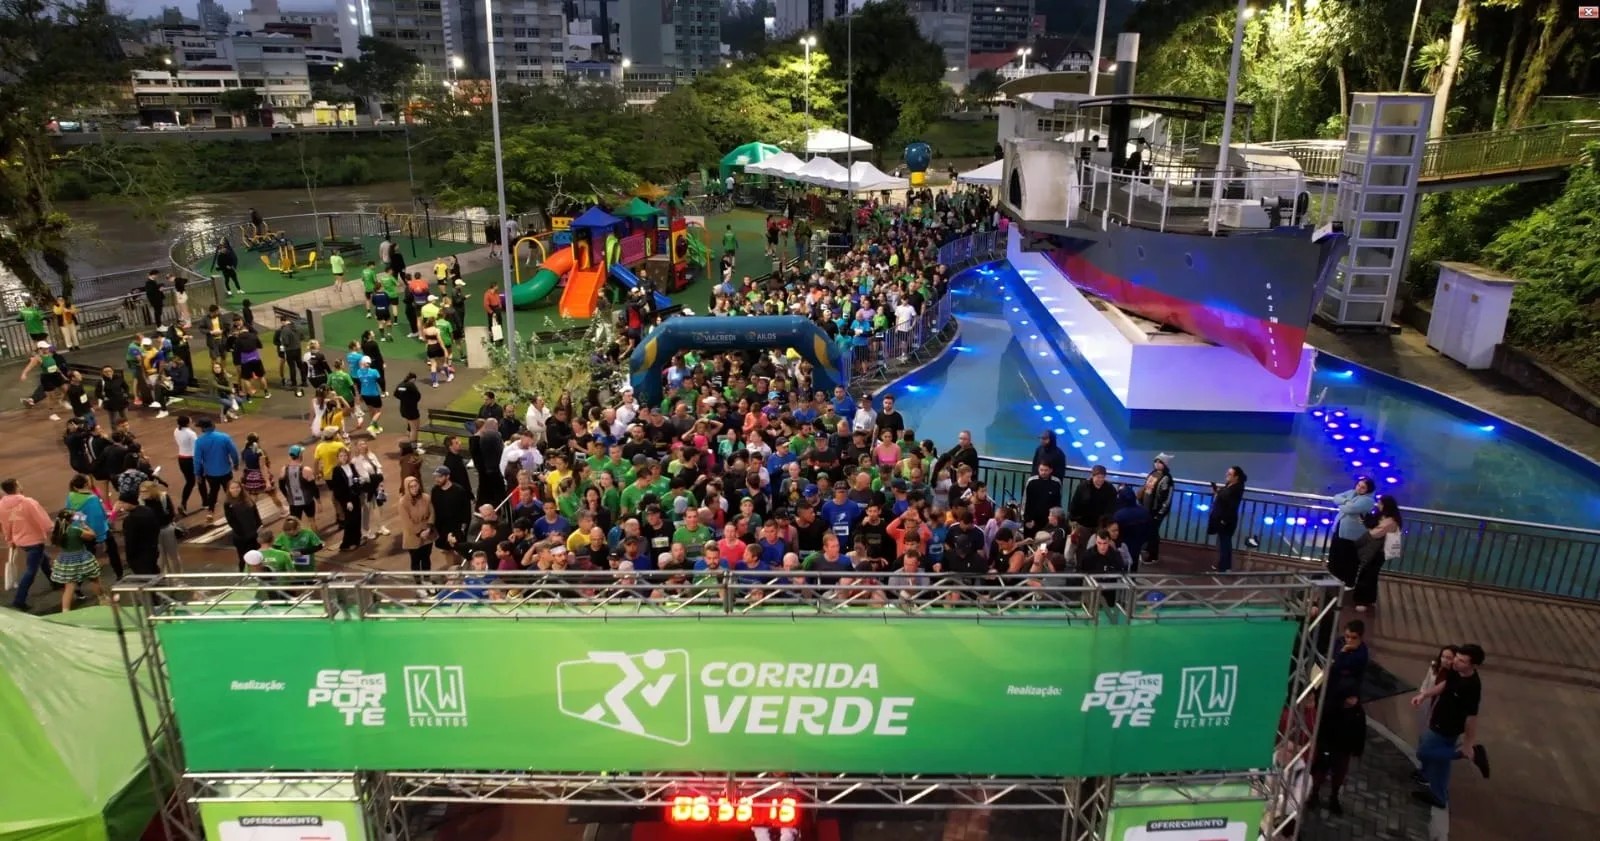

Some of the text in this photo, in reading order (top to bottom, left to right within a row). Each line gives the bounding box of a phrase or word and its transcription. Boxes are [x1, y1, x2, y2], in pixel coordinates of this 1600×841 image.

[316, 669, 362, 688] ES
[701, 662, 879, 688] CORRIDA
[1094, 671, 1143, 692] ES
[230, 680, 286, 692] Realização:
[1007, 685, 1062, 697] Realização:
[307, 688, 383, 707] POR
[1081, 690, 1156, 711] POR
[339, 708, 386, 726] TE
[410, 717, 468, 727] EVENTOS
[703, 695, 915, 736] VERDE
[1109, 708, 1155, 728] TE
[1174, 717, 1230, 729] EVENTOS
[242, 817, 319, 825] OFERECIMENTO
[1150, 819, 1224, 830] OFERECIMENTO
